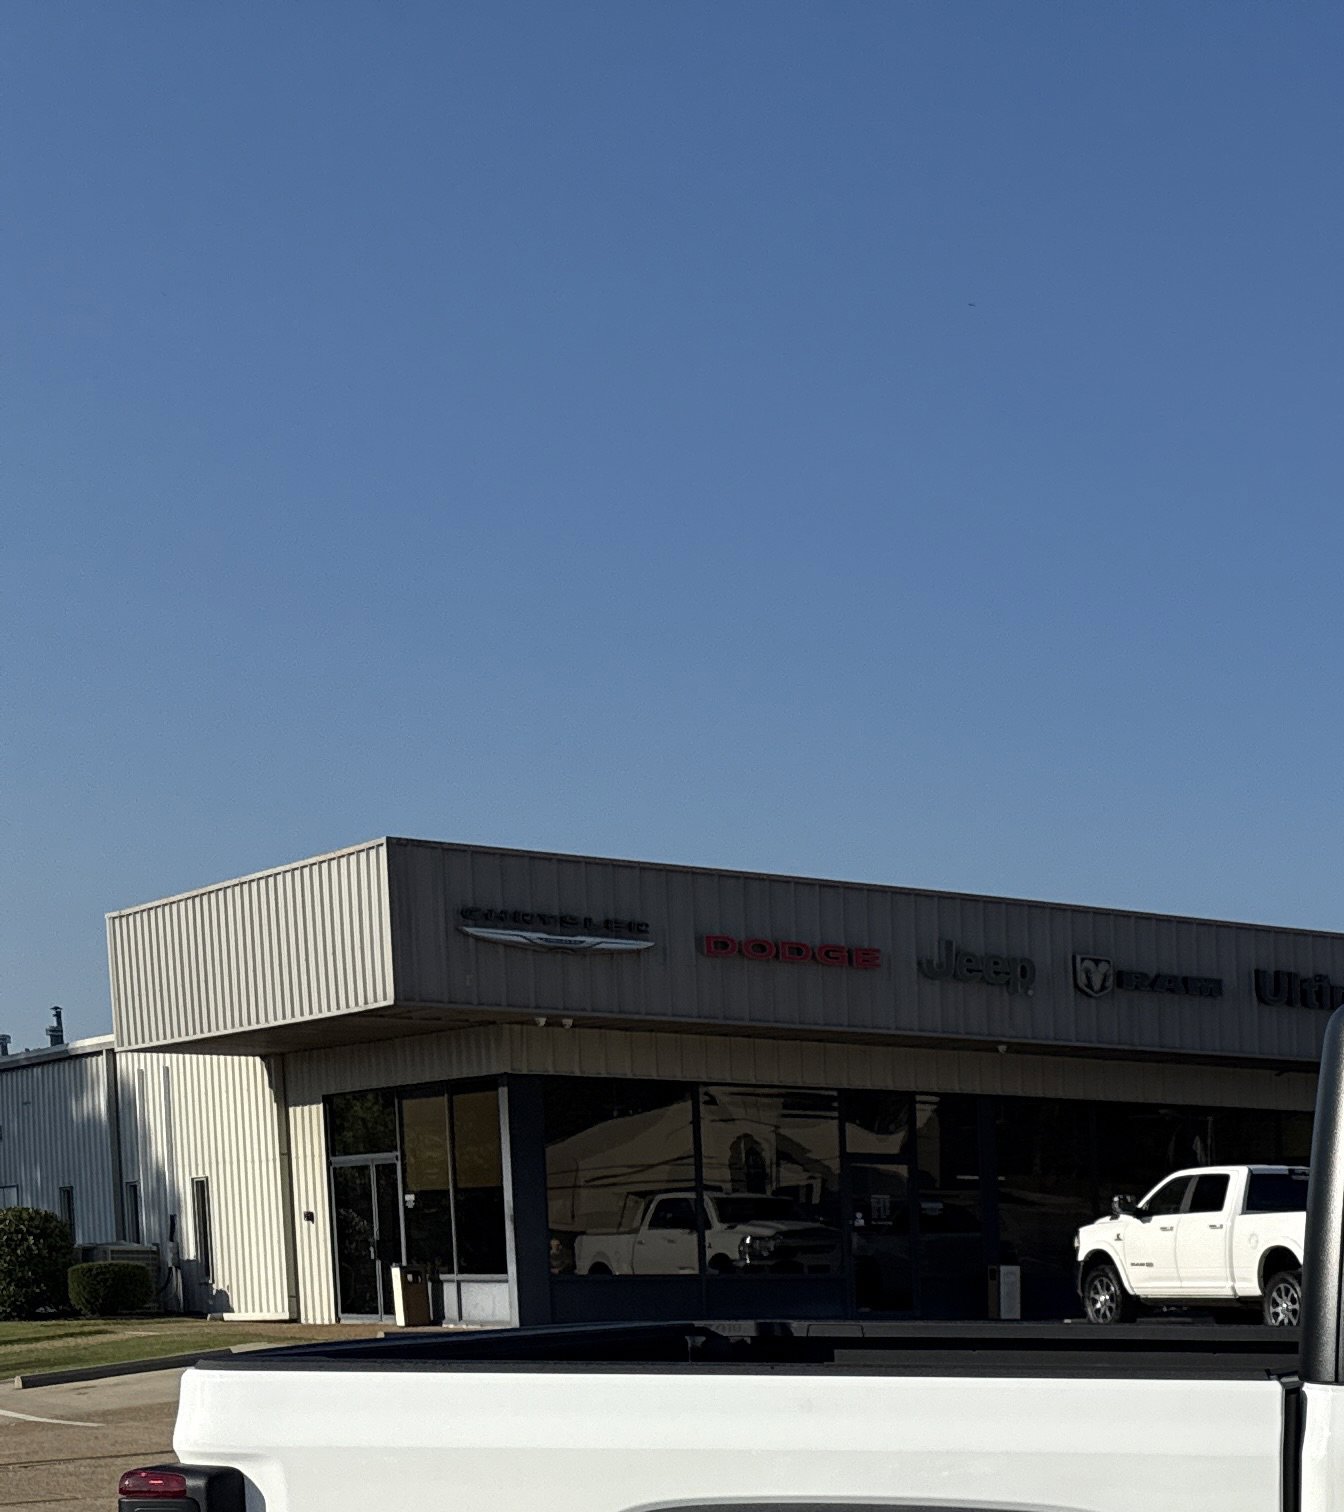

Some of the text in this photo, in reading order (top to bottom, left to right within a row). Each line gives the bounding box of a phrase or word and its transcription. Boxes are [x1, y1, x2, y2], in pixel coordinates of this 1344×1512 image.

[703, 935, 881, 969] DODGE
[918, 939, 1036, 996] Jeep
[1116, 970, 1223, 997] RAM
